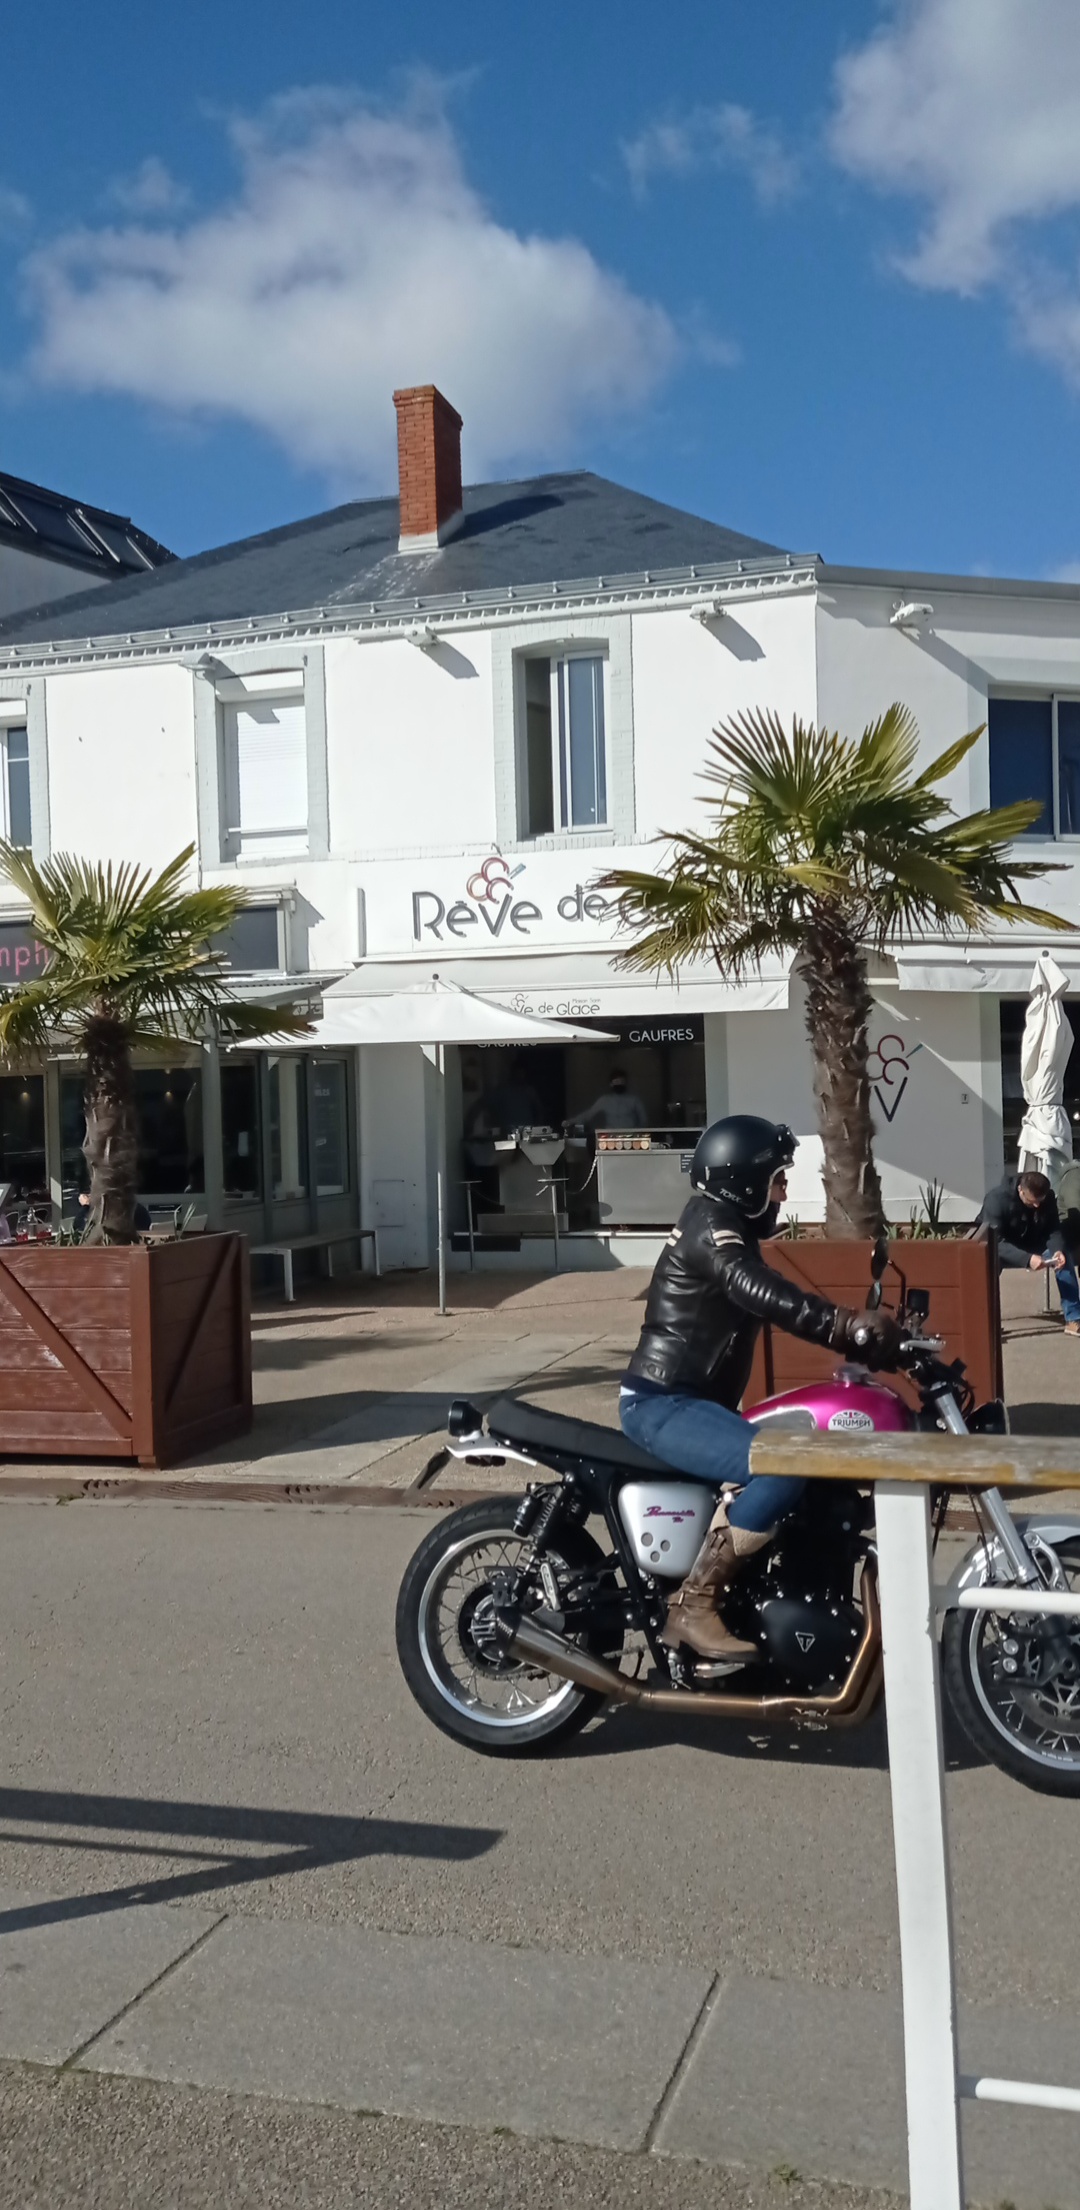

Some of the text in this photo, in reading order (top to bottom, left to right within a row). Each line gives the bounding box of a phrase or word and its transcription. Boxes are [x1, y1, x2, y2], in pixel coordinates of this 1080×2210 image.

[556, 883, 608, 922] de
[538, 1002, 554, 1014] de
[556, 1001, 601, 1016] Glace
[629, 1028, 694, 1043] GAUFRES
[832, 1418, 871, 1427] TRIUMPH
